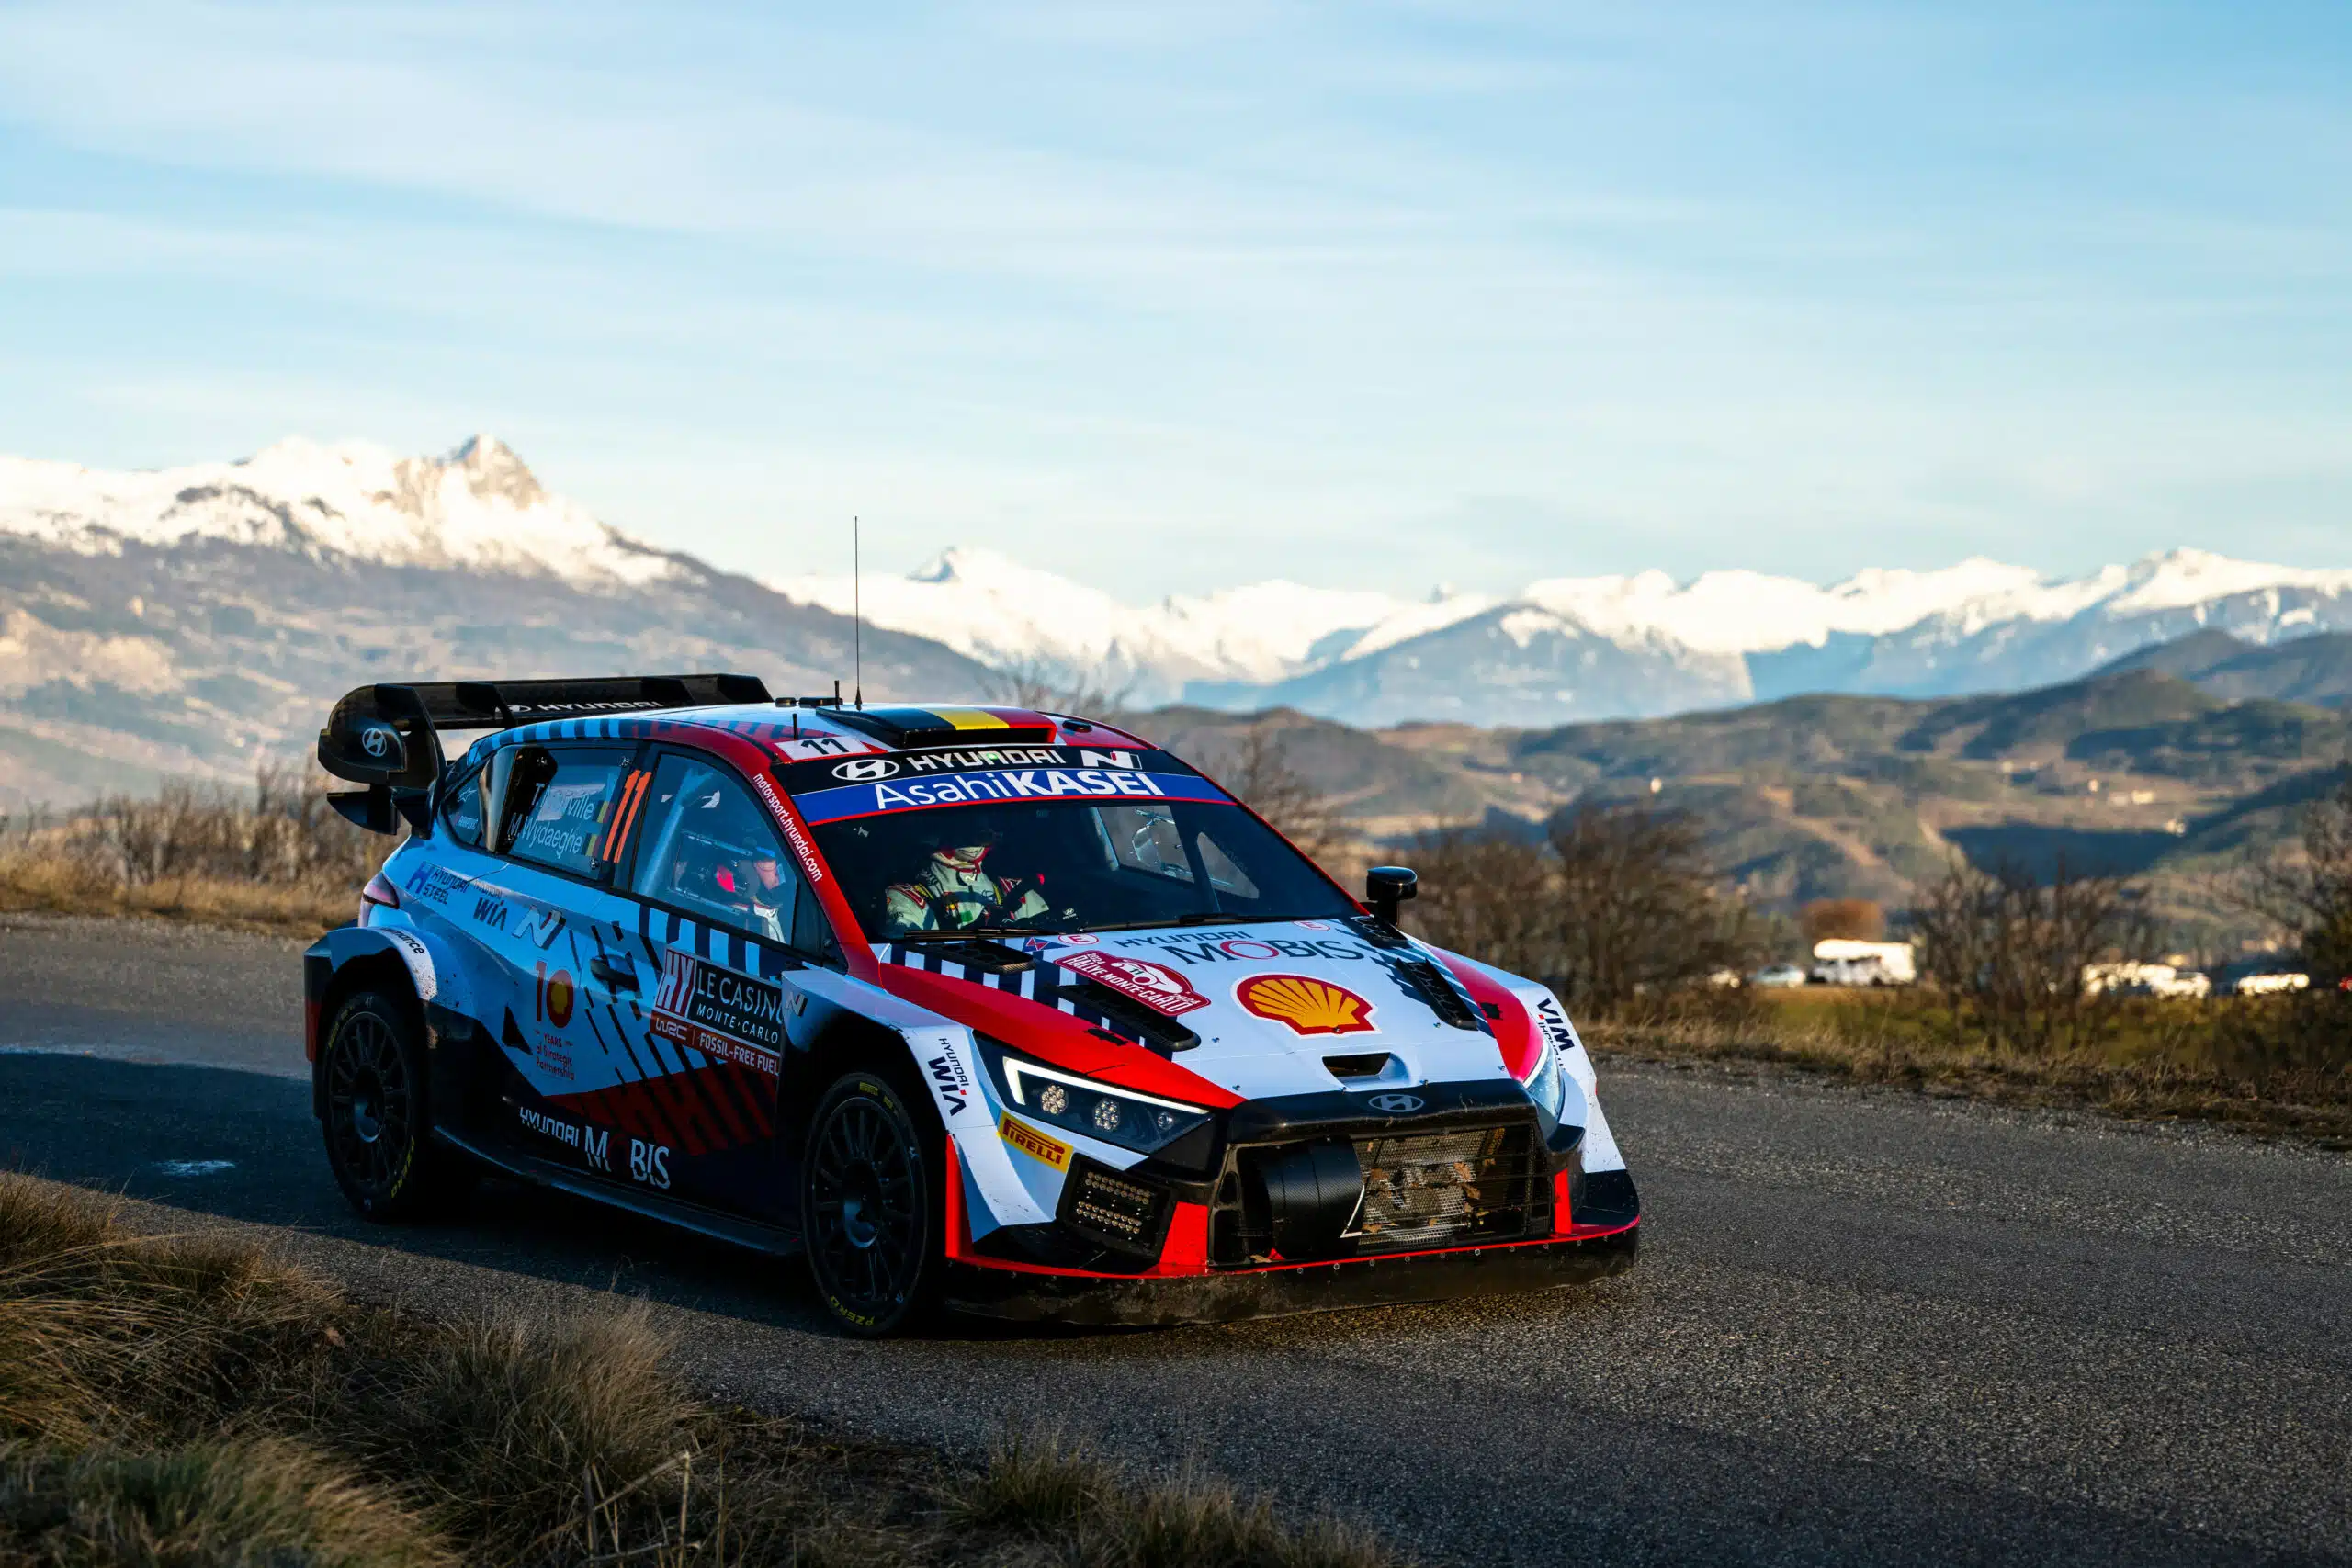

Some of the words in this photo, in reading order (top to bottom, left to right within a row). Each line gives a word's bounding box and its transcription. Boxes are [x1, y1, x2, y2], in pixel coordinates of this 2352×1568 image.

[537, 701, 664, 712] HYUNDAI
[800, 738, 851, 755] 11
[906, 750, 1067, 771] HYUNDAI
[602, 769, 653, 864] 11
[752, 773, 823, 882] motorsport.hyundai.com
[423, 883, 449, 905] STEEL
[430, 867, 471, 894] HYUNDAI
[1113, 931, 1254, 948] HYUNDAI
[1159, 939, 1365, 964] MOBIS
[536, 960, 574, 1029] 10
[696, 967, 718, 999] LE
[1061, 954, 1102, 976] RALLYE
[1100, 971, 1193, 1012] MONTE-CARLO
[655, 1017, 689, 1041] WRC
[699, 1032, 756, 1067] FOSSIL-FREE
[756, 1055, 780, 1077] FUEL
[938, 1037, 970, 1087] HYUNDAI
[519, 1105, 581, 1148] HYUNDAI
[1002, 1117, 1065, 1165] PIRELLI
